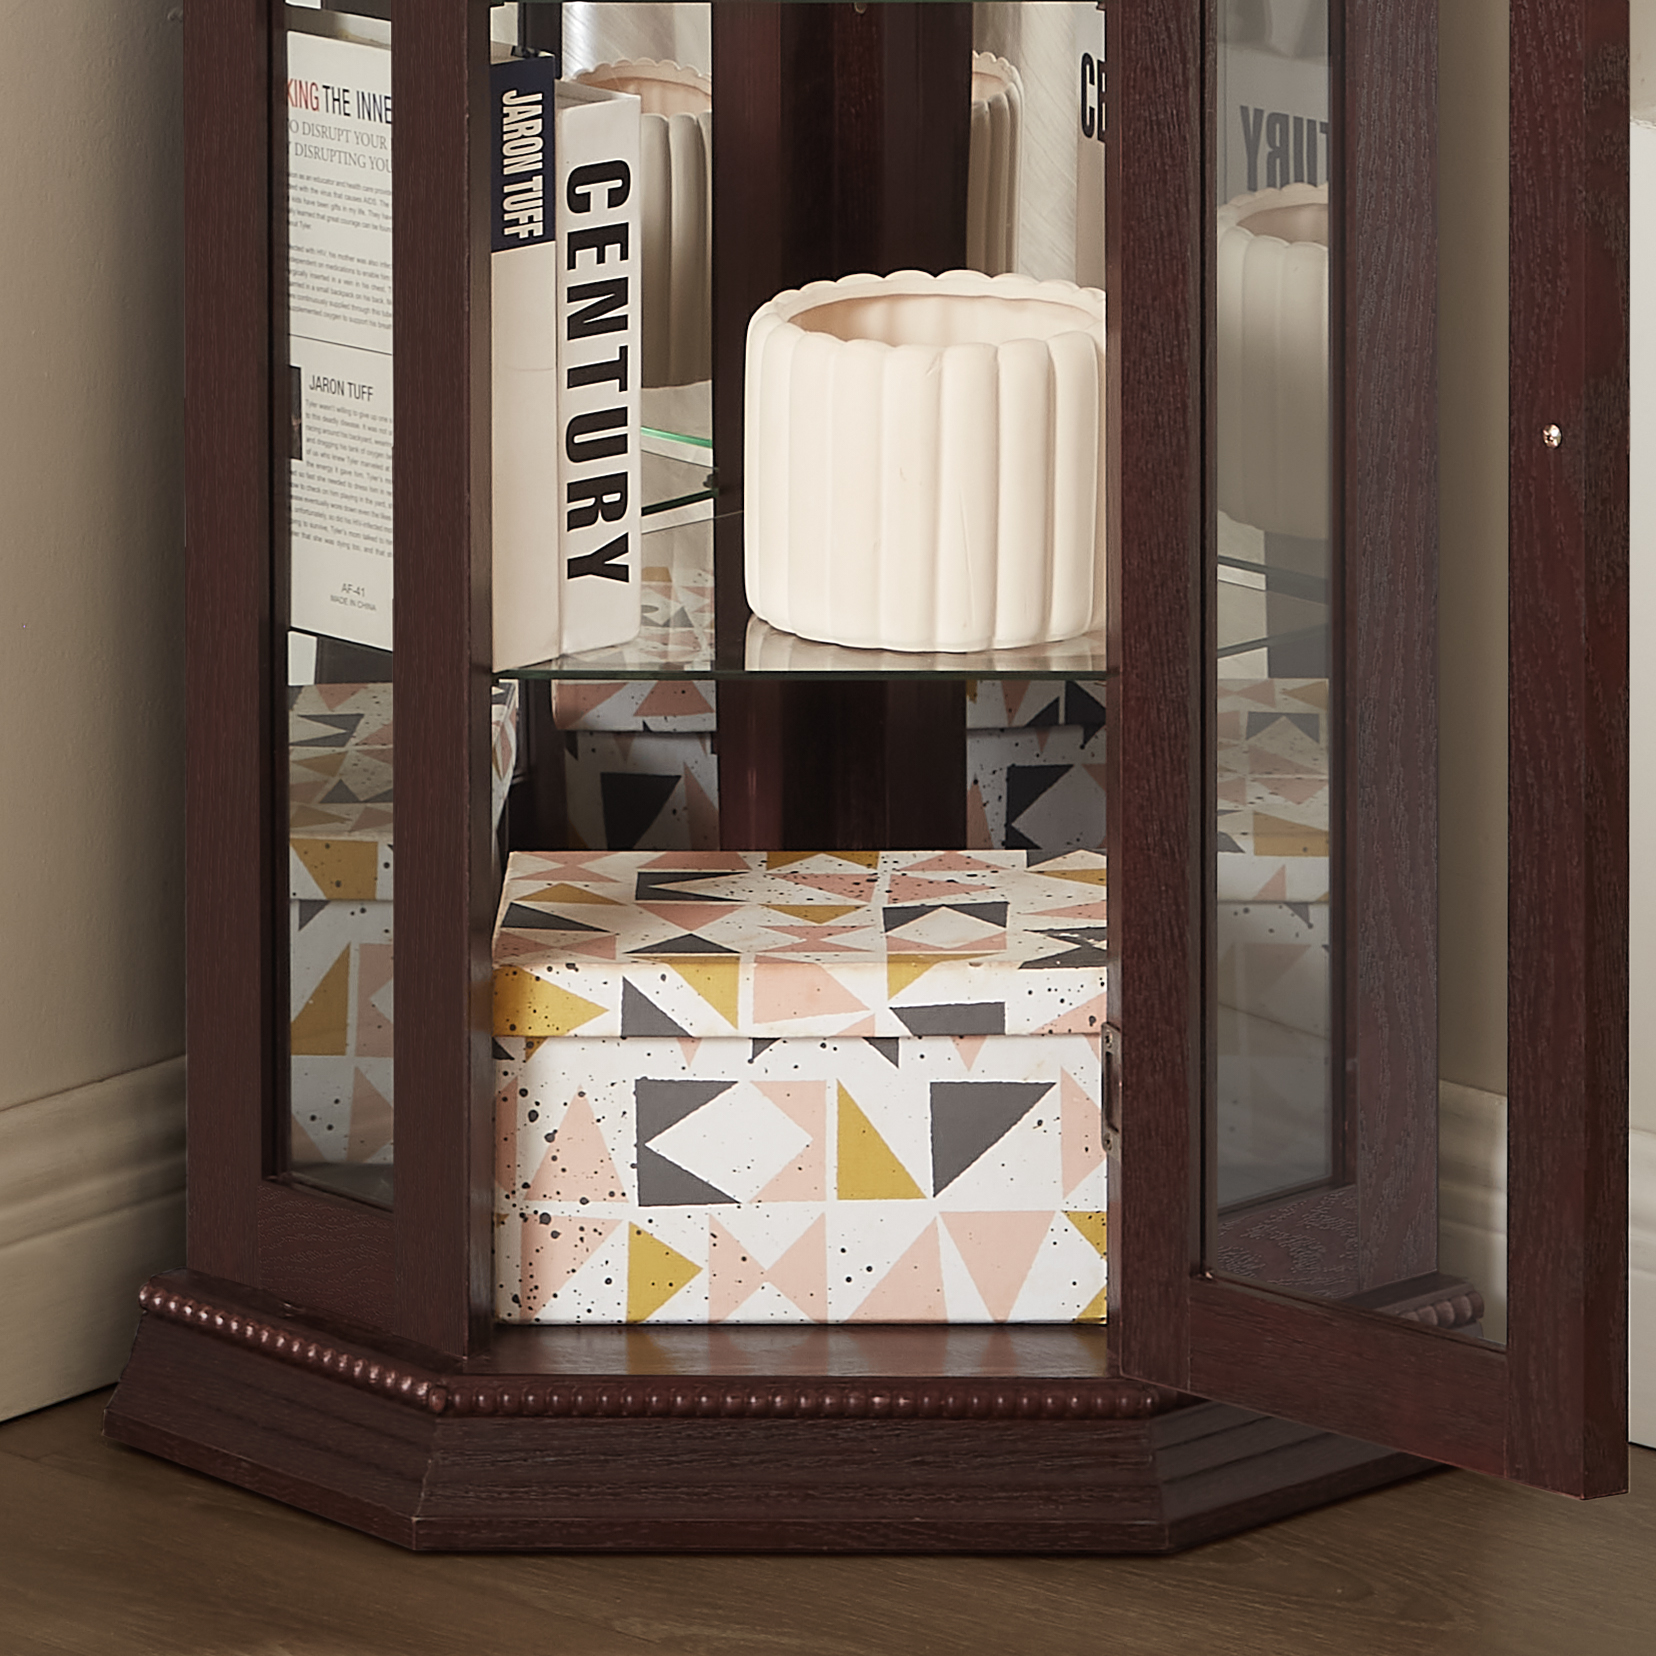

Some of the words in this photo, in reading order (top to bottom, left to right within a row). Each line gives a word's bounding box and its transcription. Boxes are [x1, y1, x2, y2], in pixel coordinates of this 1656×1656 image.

[322, 84, 351, 116] THE
[302, 121, 352, 143] DISRUPT
[353, 130, 388, 151] YOUR
[502, 89, 544, 177] JARON
[295, 142, 366, 169] DISRUPTING
[502, 175, 544, 240] TUFF
[566, 159, 631, 584] CENTURY
[308, 374, 345, 396] JARON
[347, 381, 374, 402] TUFF
